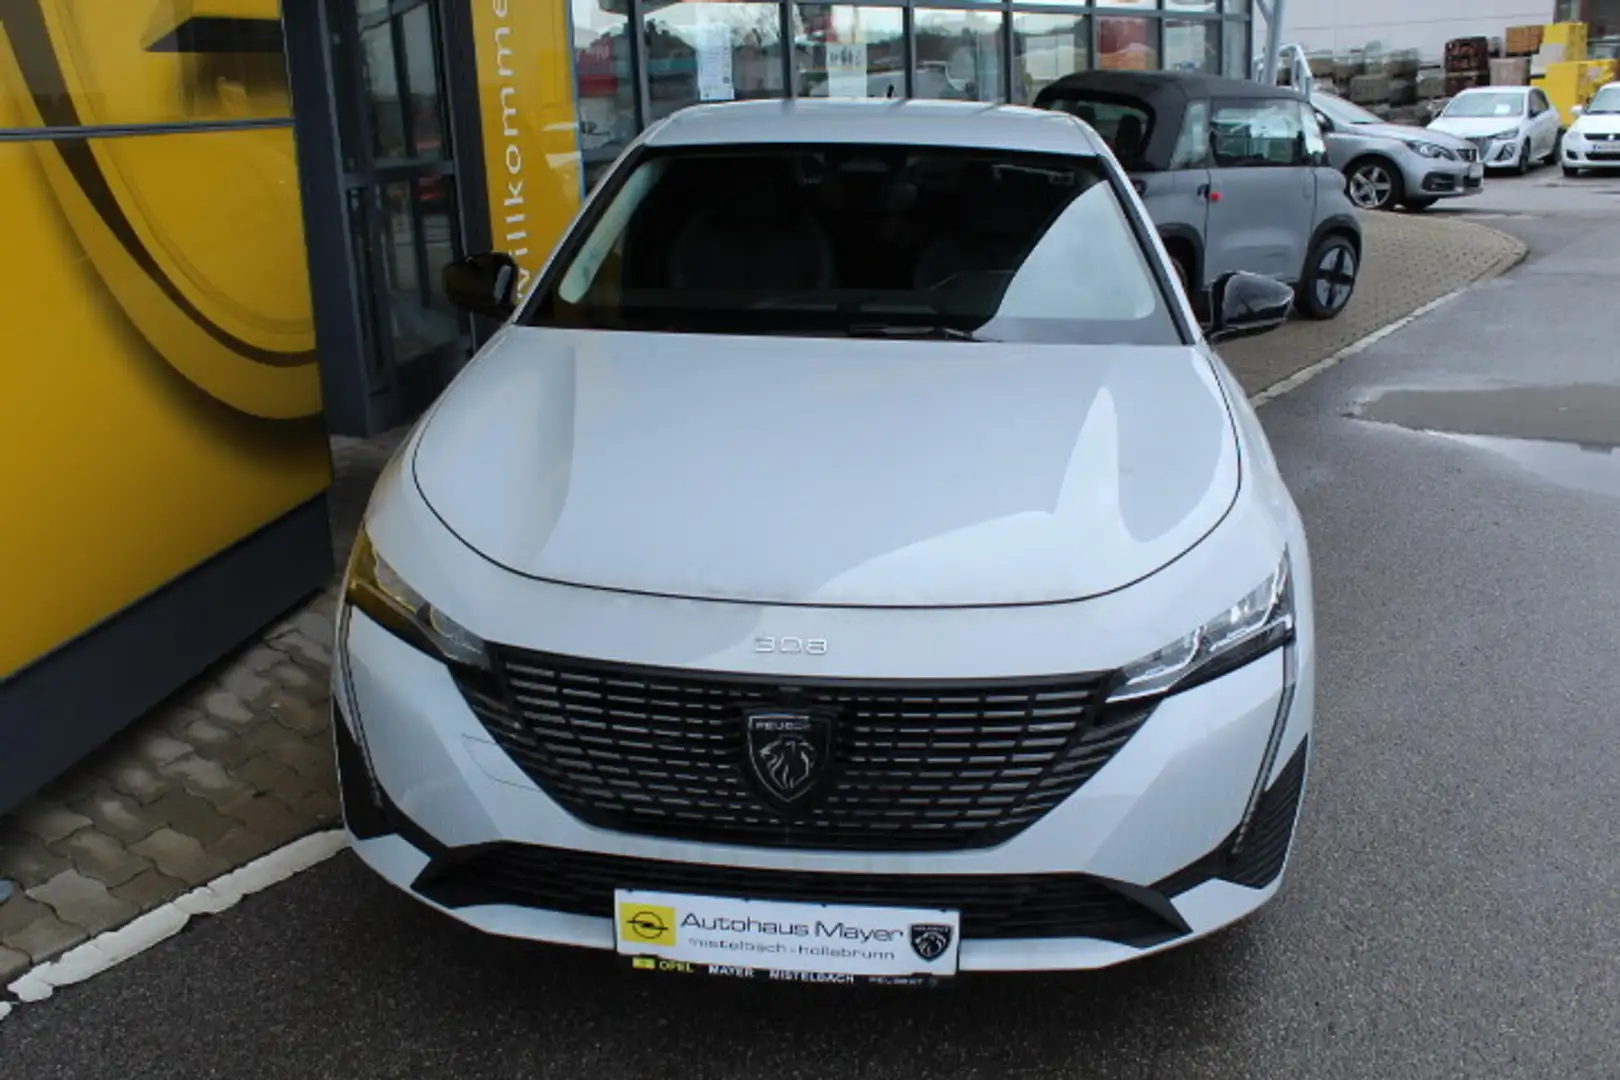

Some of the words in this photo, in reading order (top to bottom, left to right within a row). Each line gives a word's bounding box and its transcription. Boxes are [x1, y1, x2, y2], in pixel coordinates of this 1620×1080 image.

[755, 636, 828, 655] 308
[681, 912, 810, 936] Autohaus
[815, 920, 904, 944] Mayer
